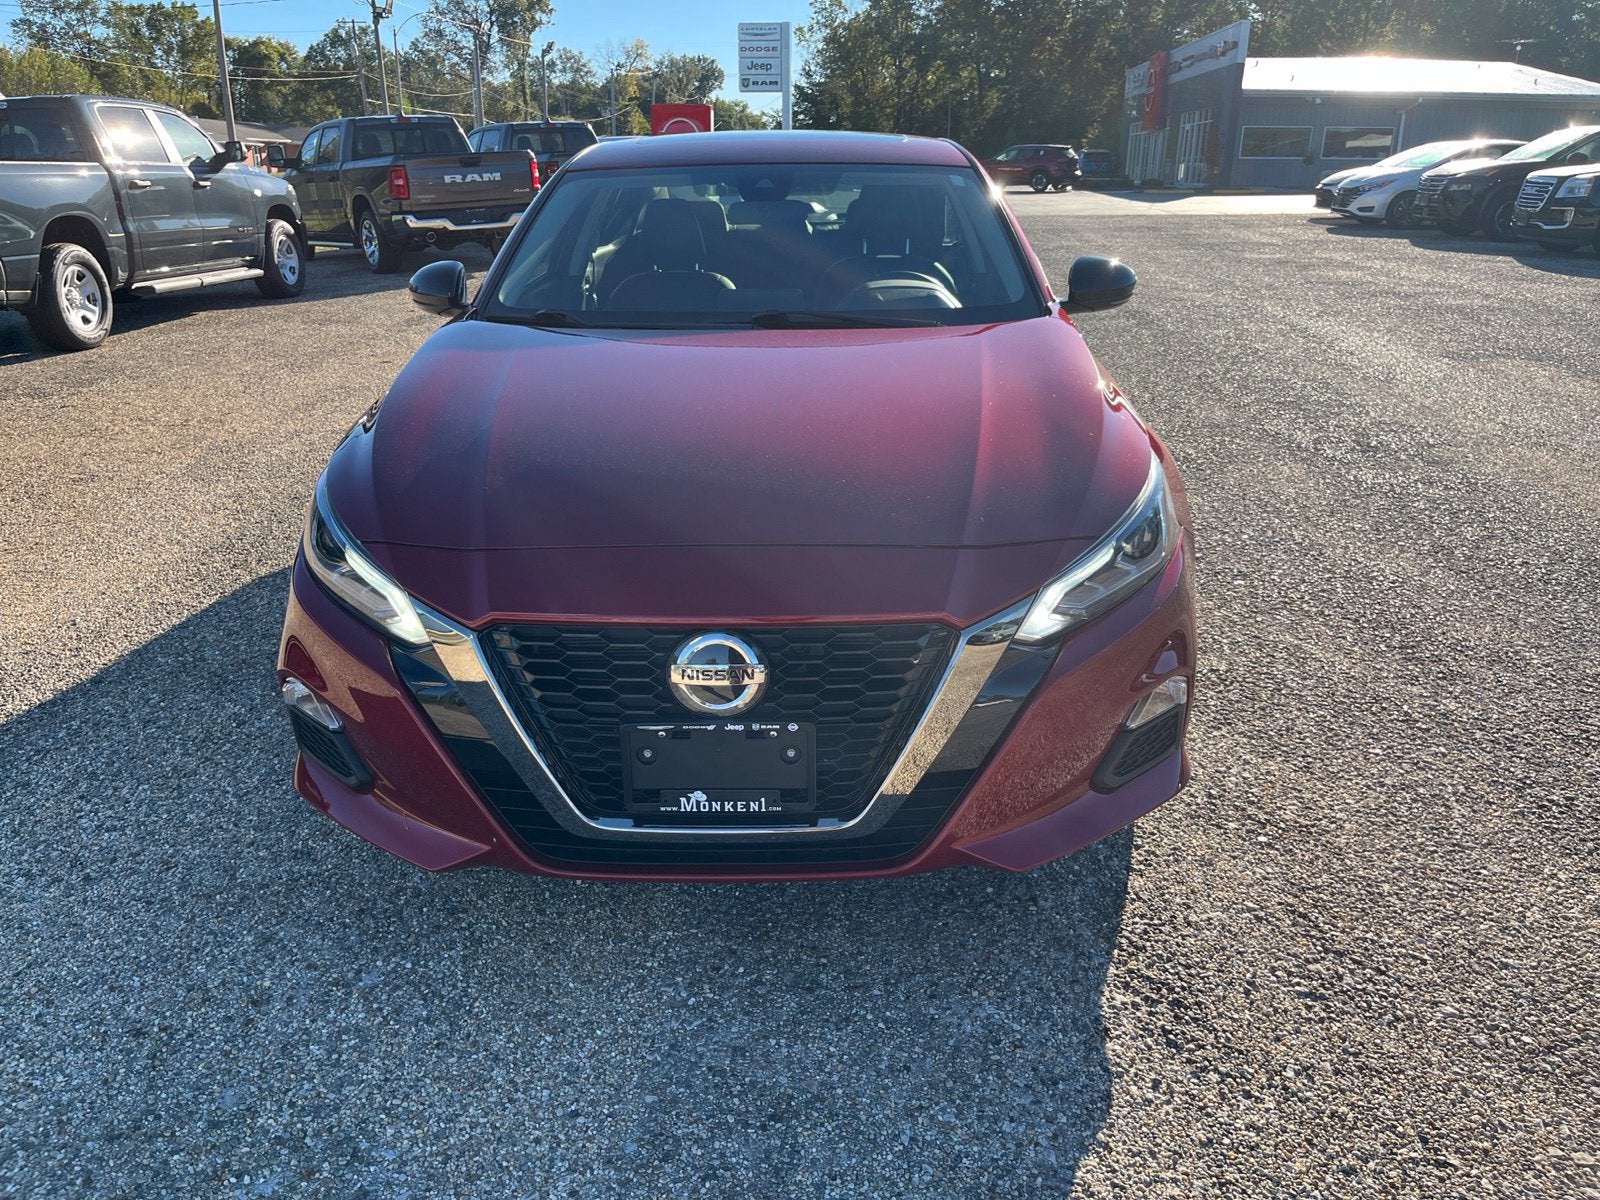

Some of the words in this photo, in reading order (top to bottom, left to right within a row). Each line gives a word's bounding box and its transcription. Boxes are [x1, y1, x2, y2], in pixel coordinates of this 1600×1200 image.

[747, 60, 772, 72] Jeep
[444, 172, 501, 183] RAM
[681, 668, 755, 681] NISSAN
[725, 723, 744, 731] Jeep
